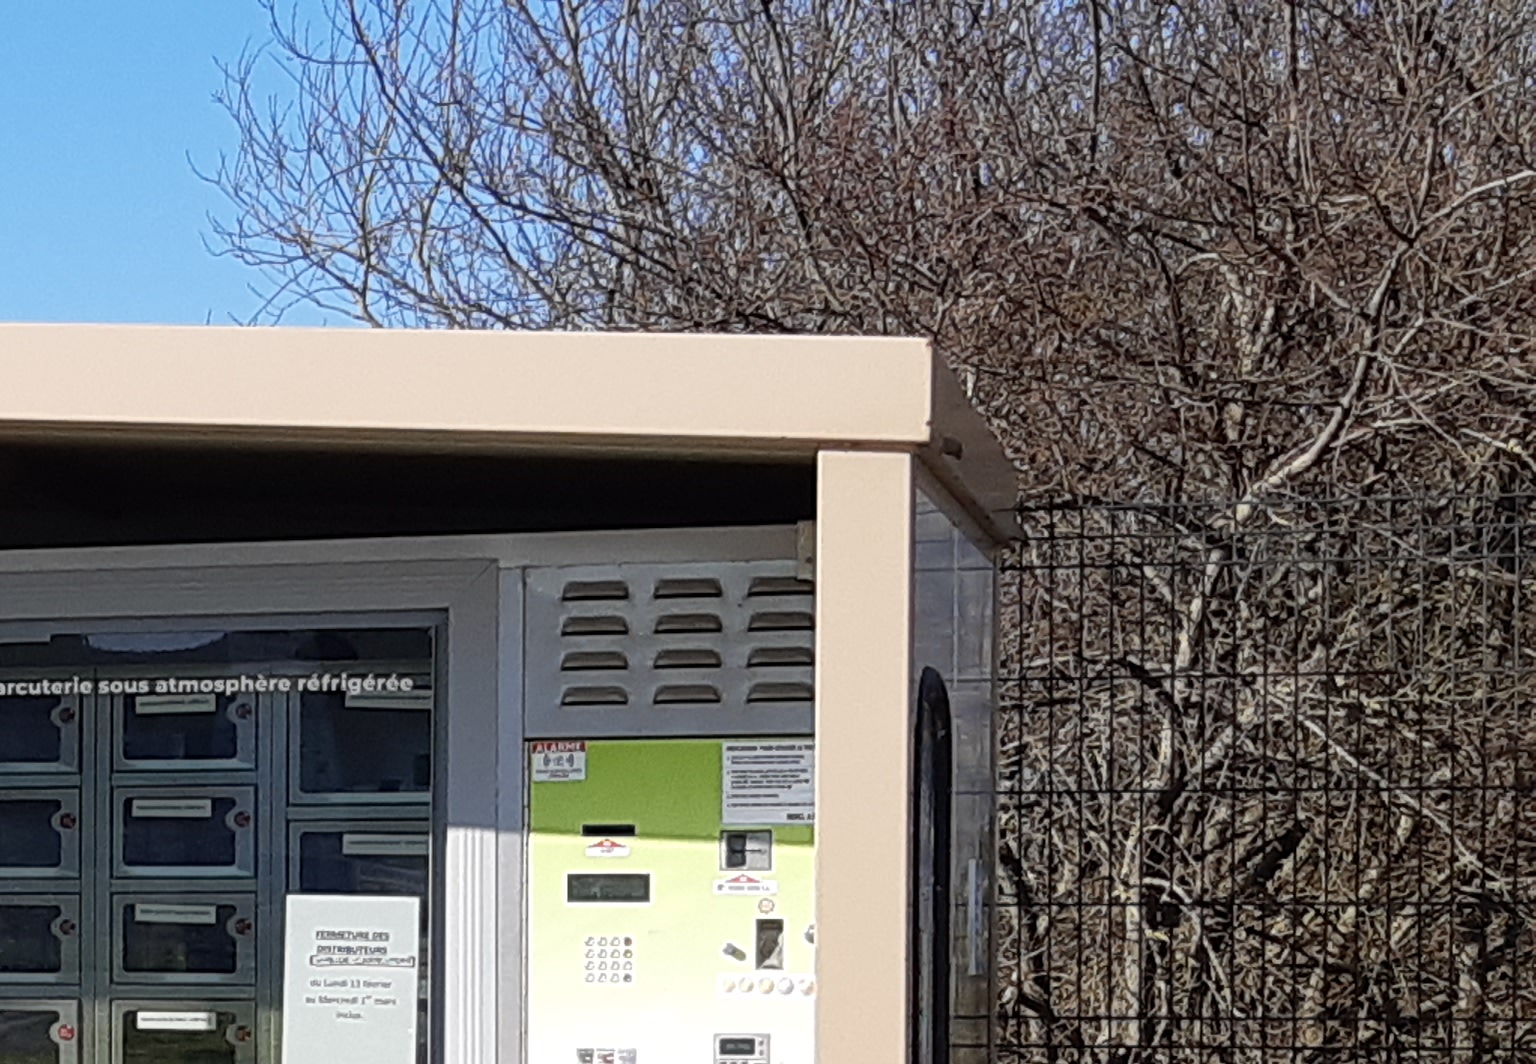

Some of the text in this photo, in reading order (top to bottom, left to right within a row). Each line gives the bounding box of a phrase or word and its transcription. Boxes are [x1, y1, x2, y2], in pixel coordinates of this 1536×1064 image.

[98, 680, 149, 693] sous
[155, 674, 291, 696] atmosphère
[298, 674, 414, 694] réfrigérée
[536, 742, 580, 752] ALARME
